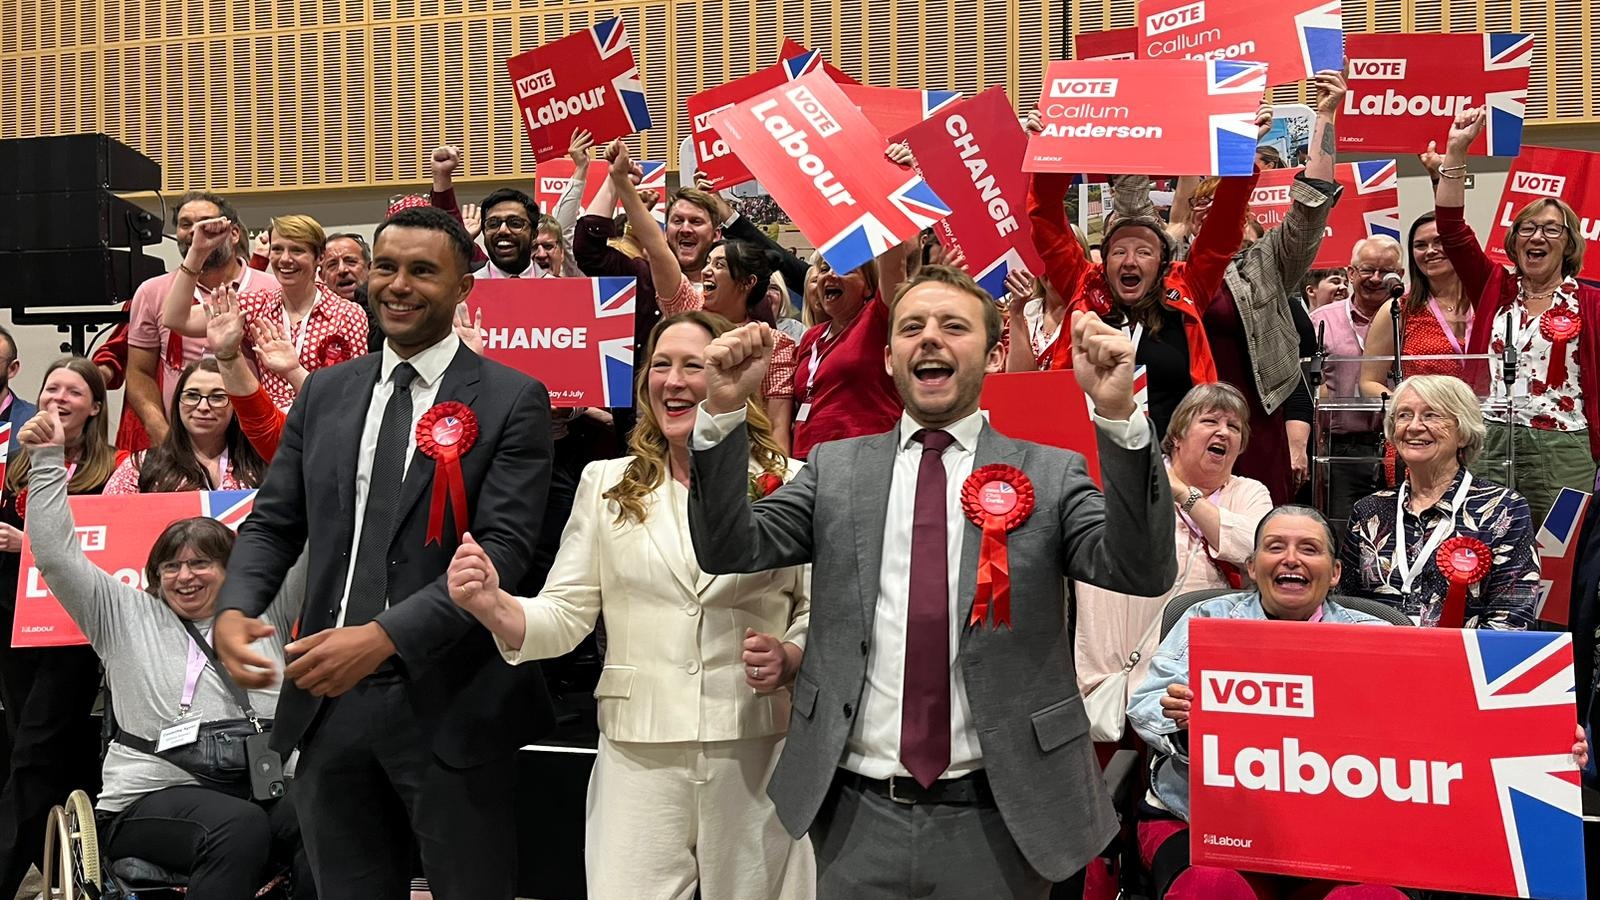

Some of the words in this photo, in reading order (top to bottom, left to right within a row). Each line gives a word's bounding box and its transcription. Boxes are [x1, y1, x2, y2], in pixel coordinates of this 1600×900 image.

[1151, 6, 1200, 31] VOTE
[1147, 28, 1221, 57] Callum
[1183, 40, 1256, 60] derson
[1353, 62, 1401, 76] VOTE
[520, 72, 552, 92] VOTE
[1056, 82, 1112, 94] VOTE
[525, 85, 606, 129] Labour
[797, 90, 835, 132] VOTE
[1046, 103, 1128, 119] Callum
[1343, 89, 1472, 117] Labour
[1040, 123, 1162, 138] Anderson
[751, 98, 856, 206] Labour
[544, 180, 569, 190] VOT
[945, 114, 1019, 237] CHANGE
[1518, 175, 1560, 192] VOTE
[1250, 210, 1286, 224] allu
[568, 389, 584, 399] July
[1209, 677, 1304, 709] VOTE
[1202, 734, 1463, 805] Labour
[1212, 835, 1252, 848] Labour
